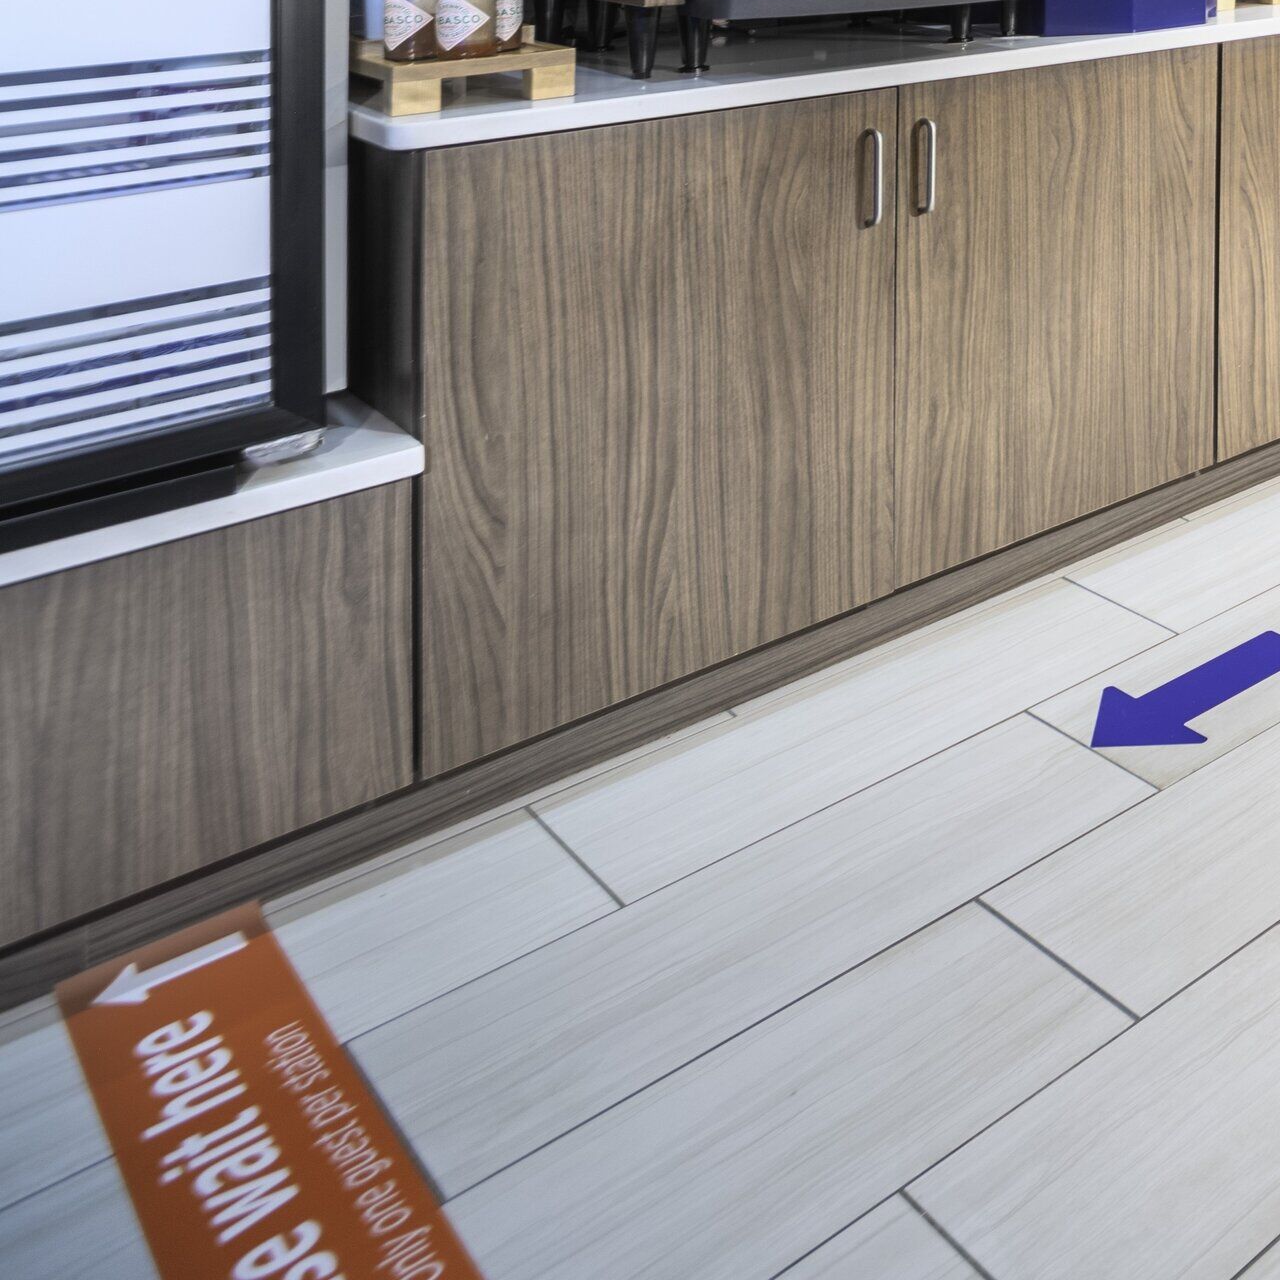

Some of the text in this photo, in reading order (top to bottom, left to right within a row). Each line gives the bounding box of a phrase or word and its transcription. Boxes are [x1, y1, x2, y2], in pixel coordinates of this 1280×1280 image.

[132, 1009, 248, 1141] here
[264, 1020, 331, 1094] station
[300, 1085, 357, 1129] per
[159, 1105, 300, 1245] wait
[312, 1118, 393, 1190] guest
[355, 1179, 412, 1235] one
